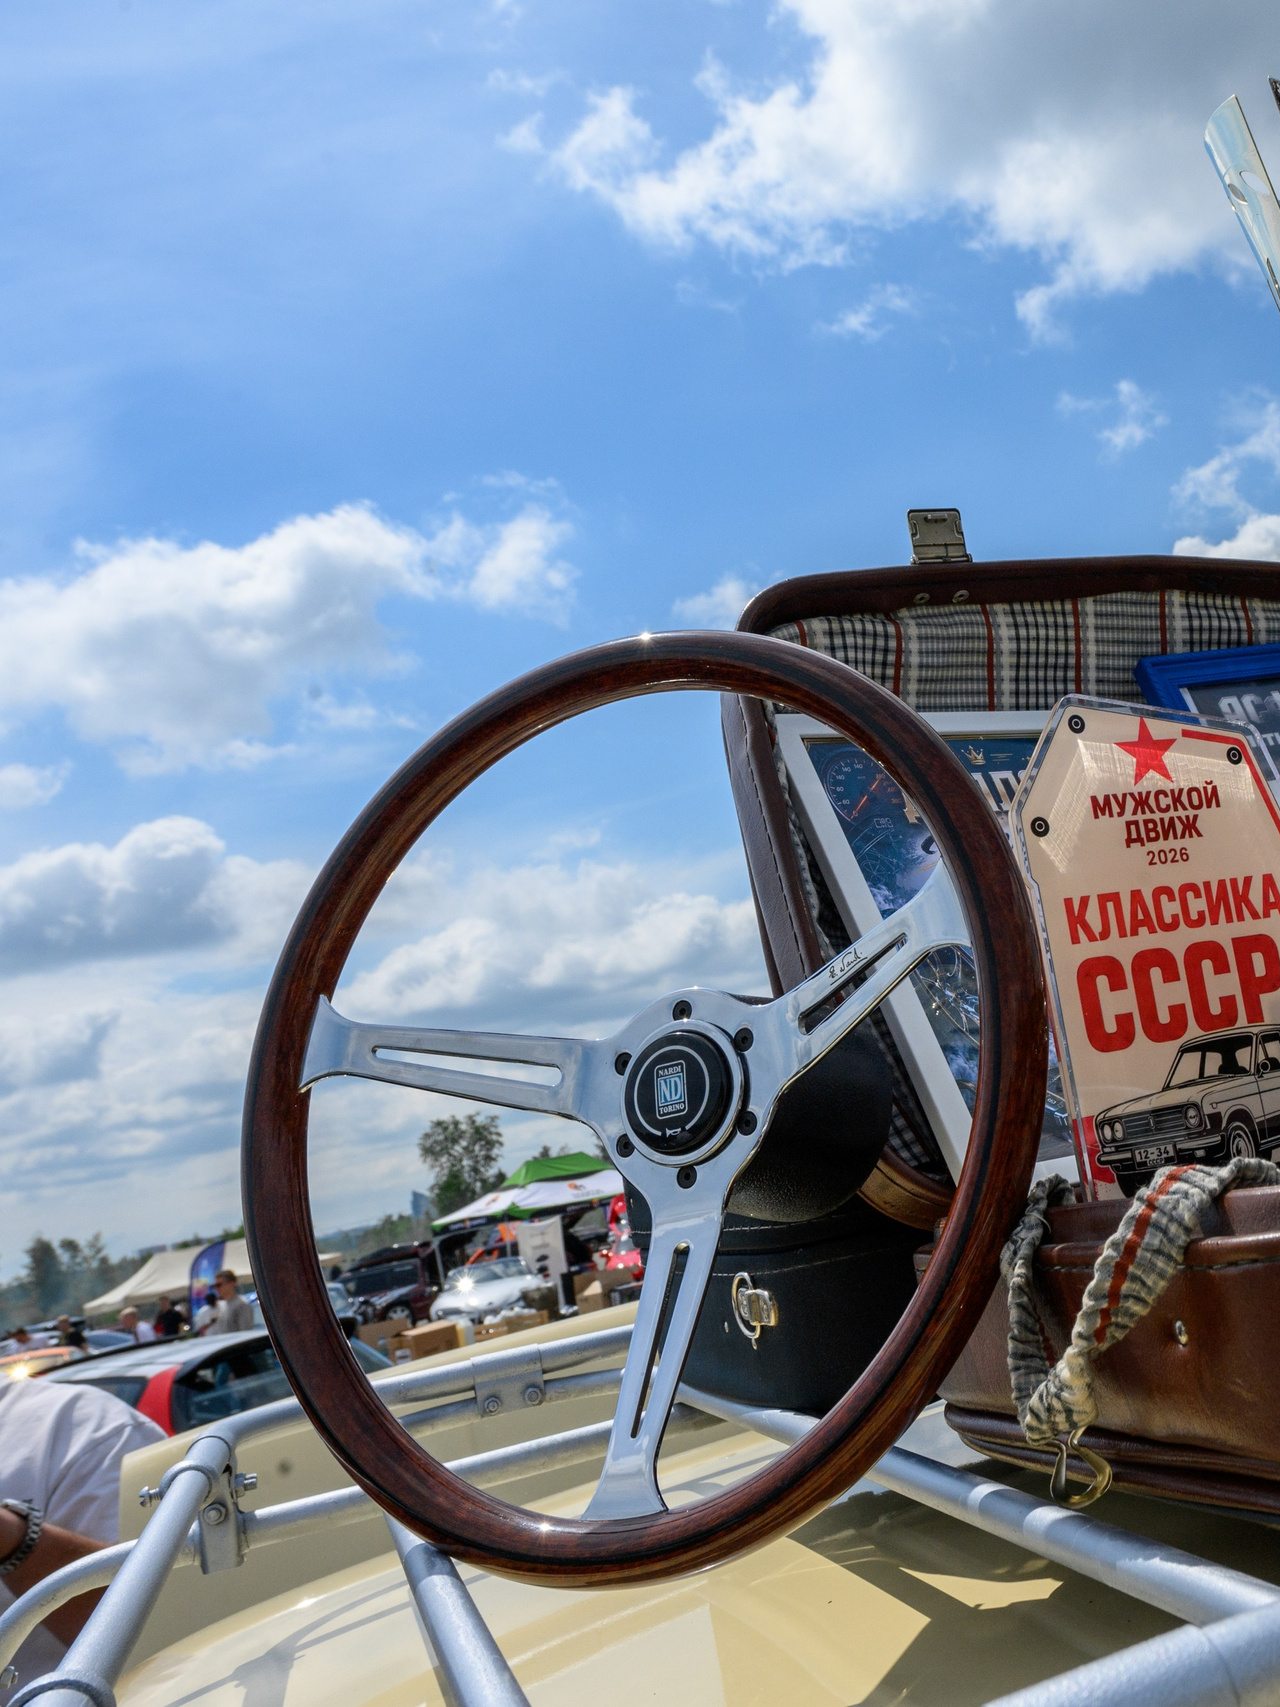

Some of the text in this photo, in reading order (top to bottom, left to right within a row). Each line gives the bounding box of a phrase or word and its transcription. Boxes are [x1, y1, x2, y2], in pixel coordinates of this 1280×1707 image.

[1090, 780, 1221, 819] МУЖСКОЙ
[1125, 814, 1203, 848] ДВИЖ
[1146, 847, 1190, 866] 2026
[658, 1065, 682, 1077] NARDI
[660, 1077, 683, 1103] ND
[659, 1103, 685, 1114] TORINO
[1137, 1145, 1170, 1161] 12-34
